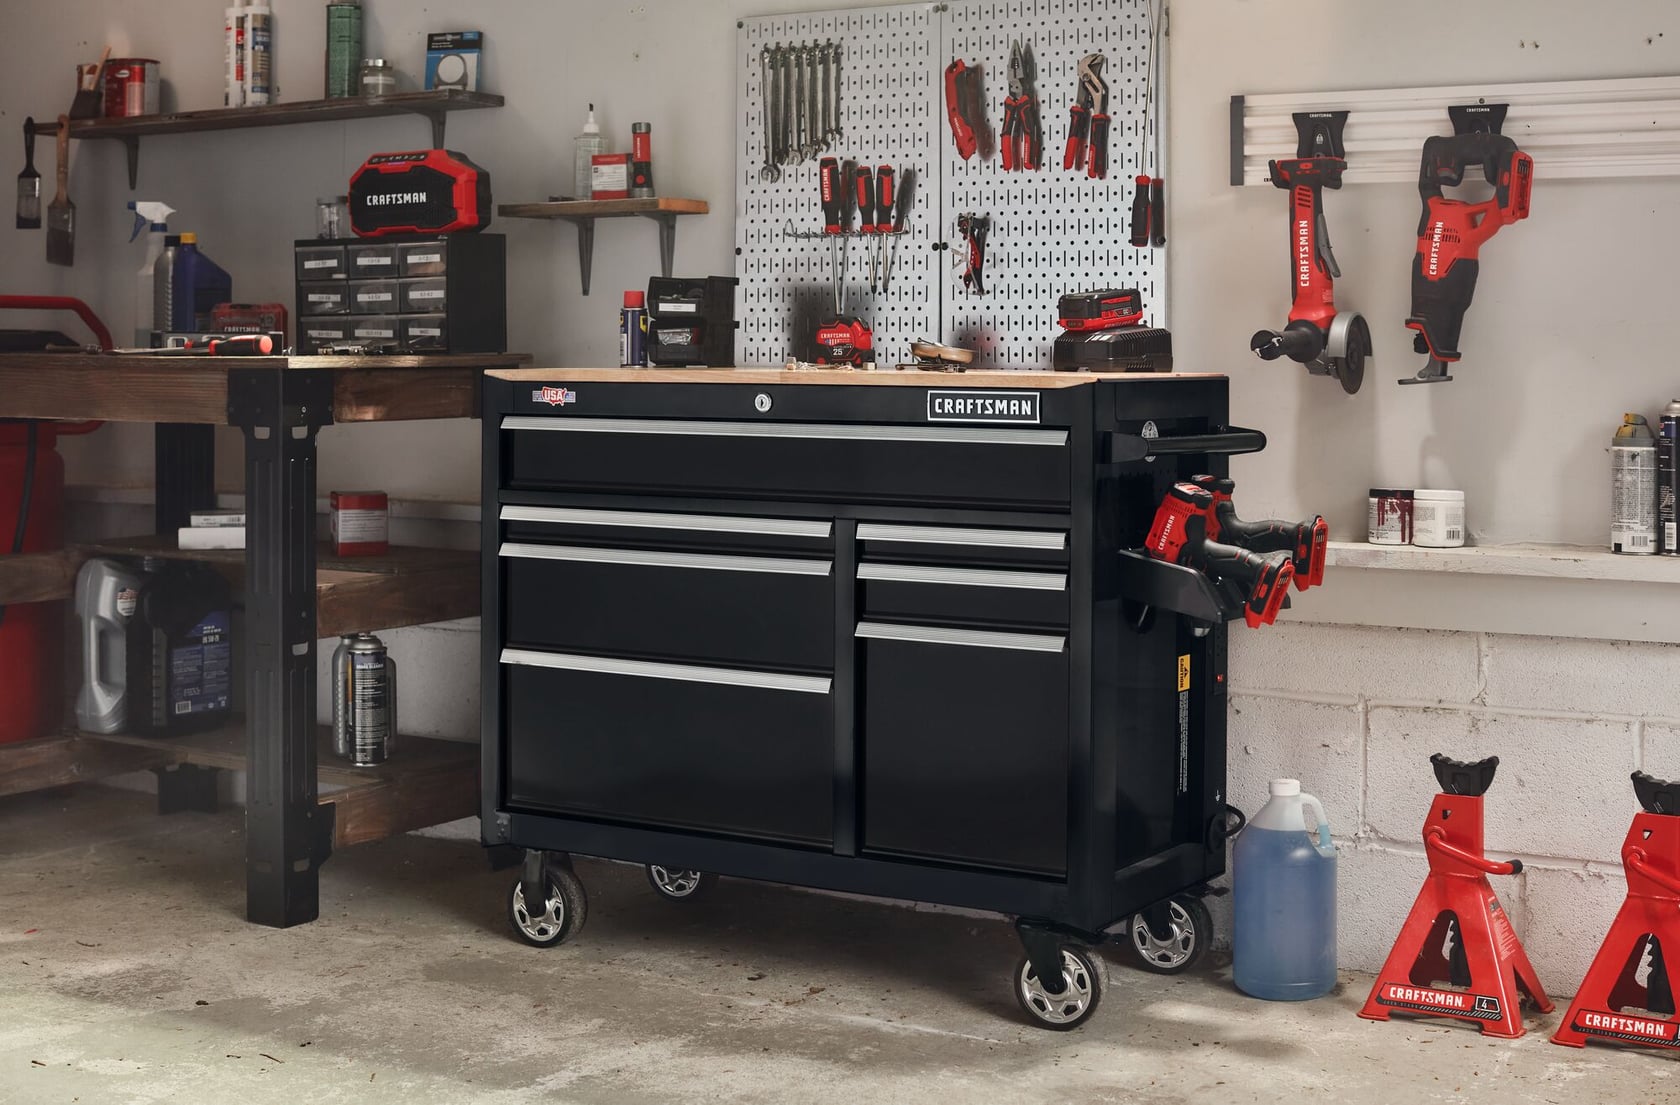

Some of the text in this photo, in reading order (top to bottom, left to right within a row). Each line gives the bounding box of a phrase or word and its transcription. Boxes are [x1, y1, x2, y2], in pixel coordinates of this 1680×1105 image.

[822, 168, 830, 201] CRAFTSMAN
[366, 191, 427, 206] CRAFTSMAN
[1299, 220, 1310, 287] CRAFTSMAN
[1429, 221, 1444, 275] CRAFTSMAN
[544, 389, 564, 401] USA
[934, 398, 1032, 415] CRAFTSMAN
[1158, 515, 1176, 551] CRAFTSMAN
[1389, 986, 1463, 1008] CRAFTSMAN
[1480, 999, 1488, 1010] 4
[1585, 1013, 1665, 1037] CRAFTSMAN
